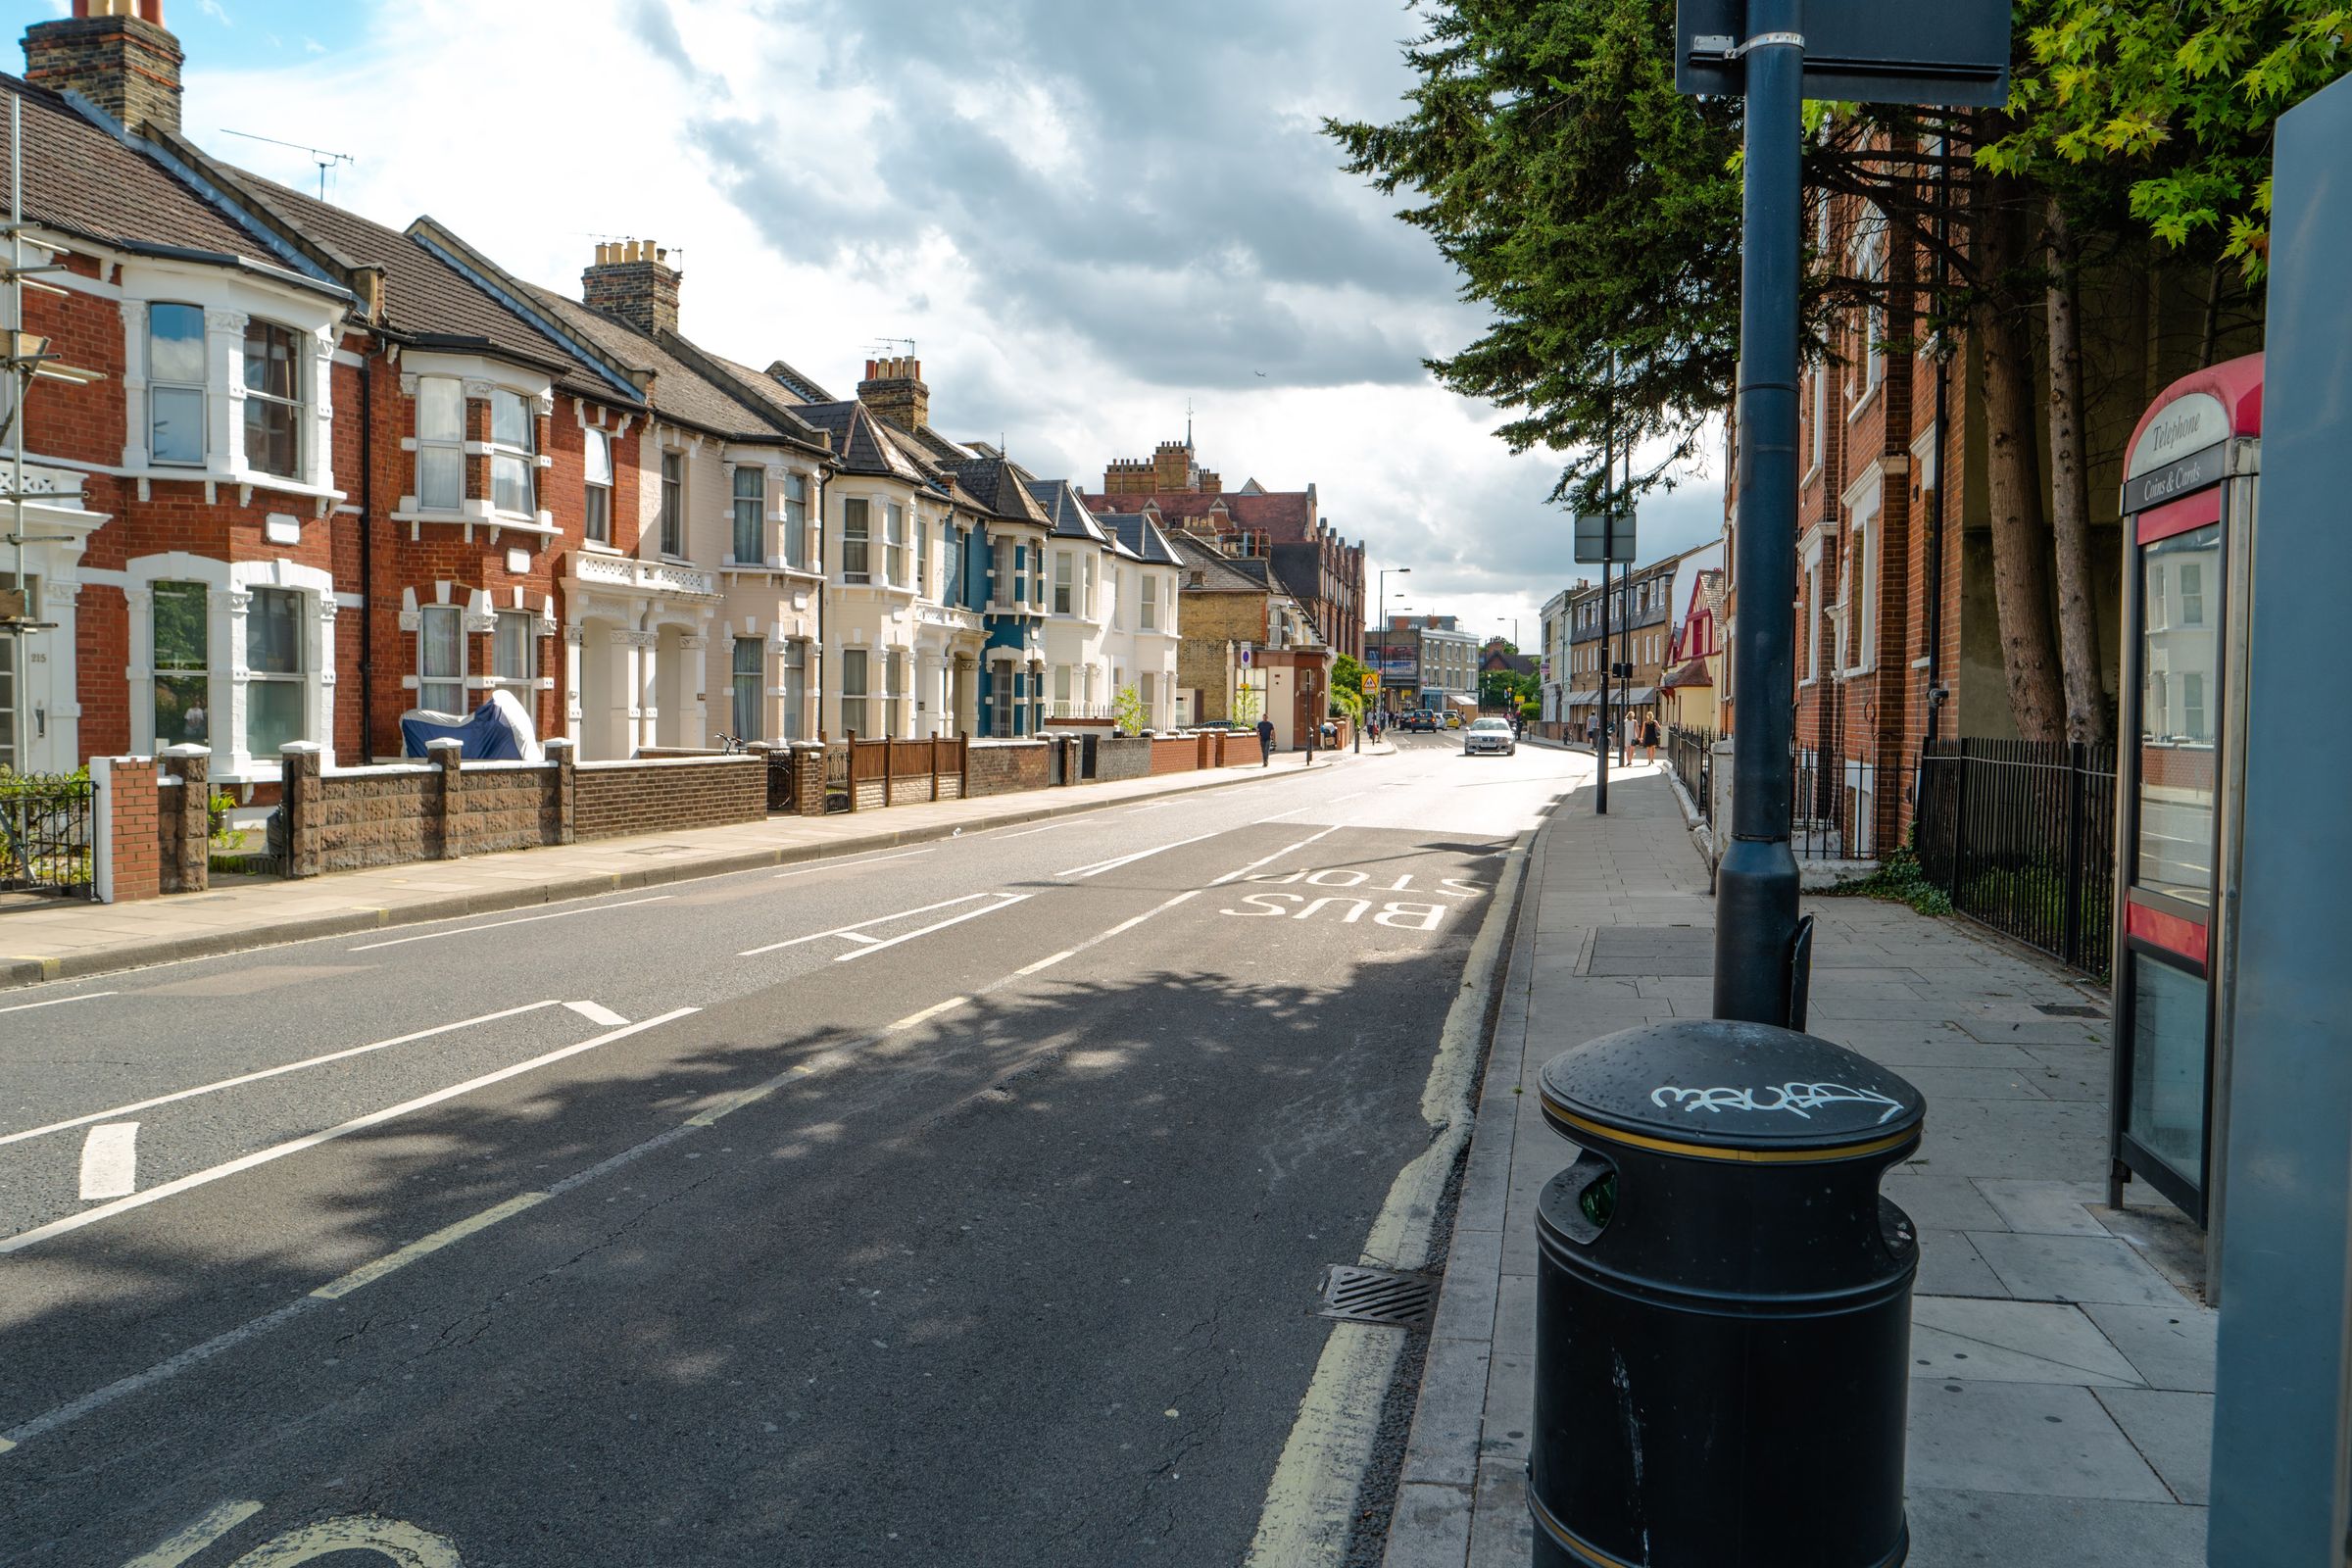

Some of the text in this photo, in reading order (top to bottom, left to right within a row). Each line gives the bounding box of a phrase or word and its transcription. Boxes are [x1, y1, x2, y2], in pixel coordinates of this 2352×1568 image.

[2152, 413, 2201, 452] Telephone
[2143, 462, 2201, 502] Coins & Cards
[30, 653, 47, 663] 215
[1242, 869, 1493, 899] STOP
[1218, 893, 1447, 931] BUS
